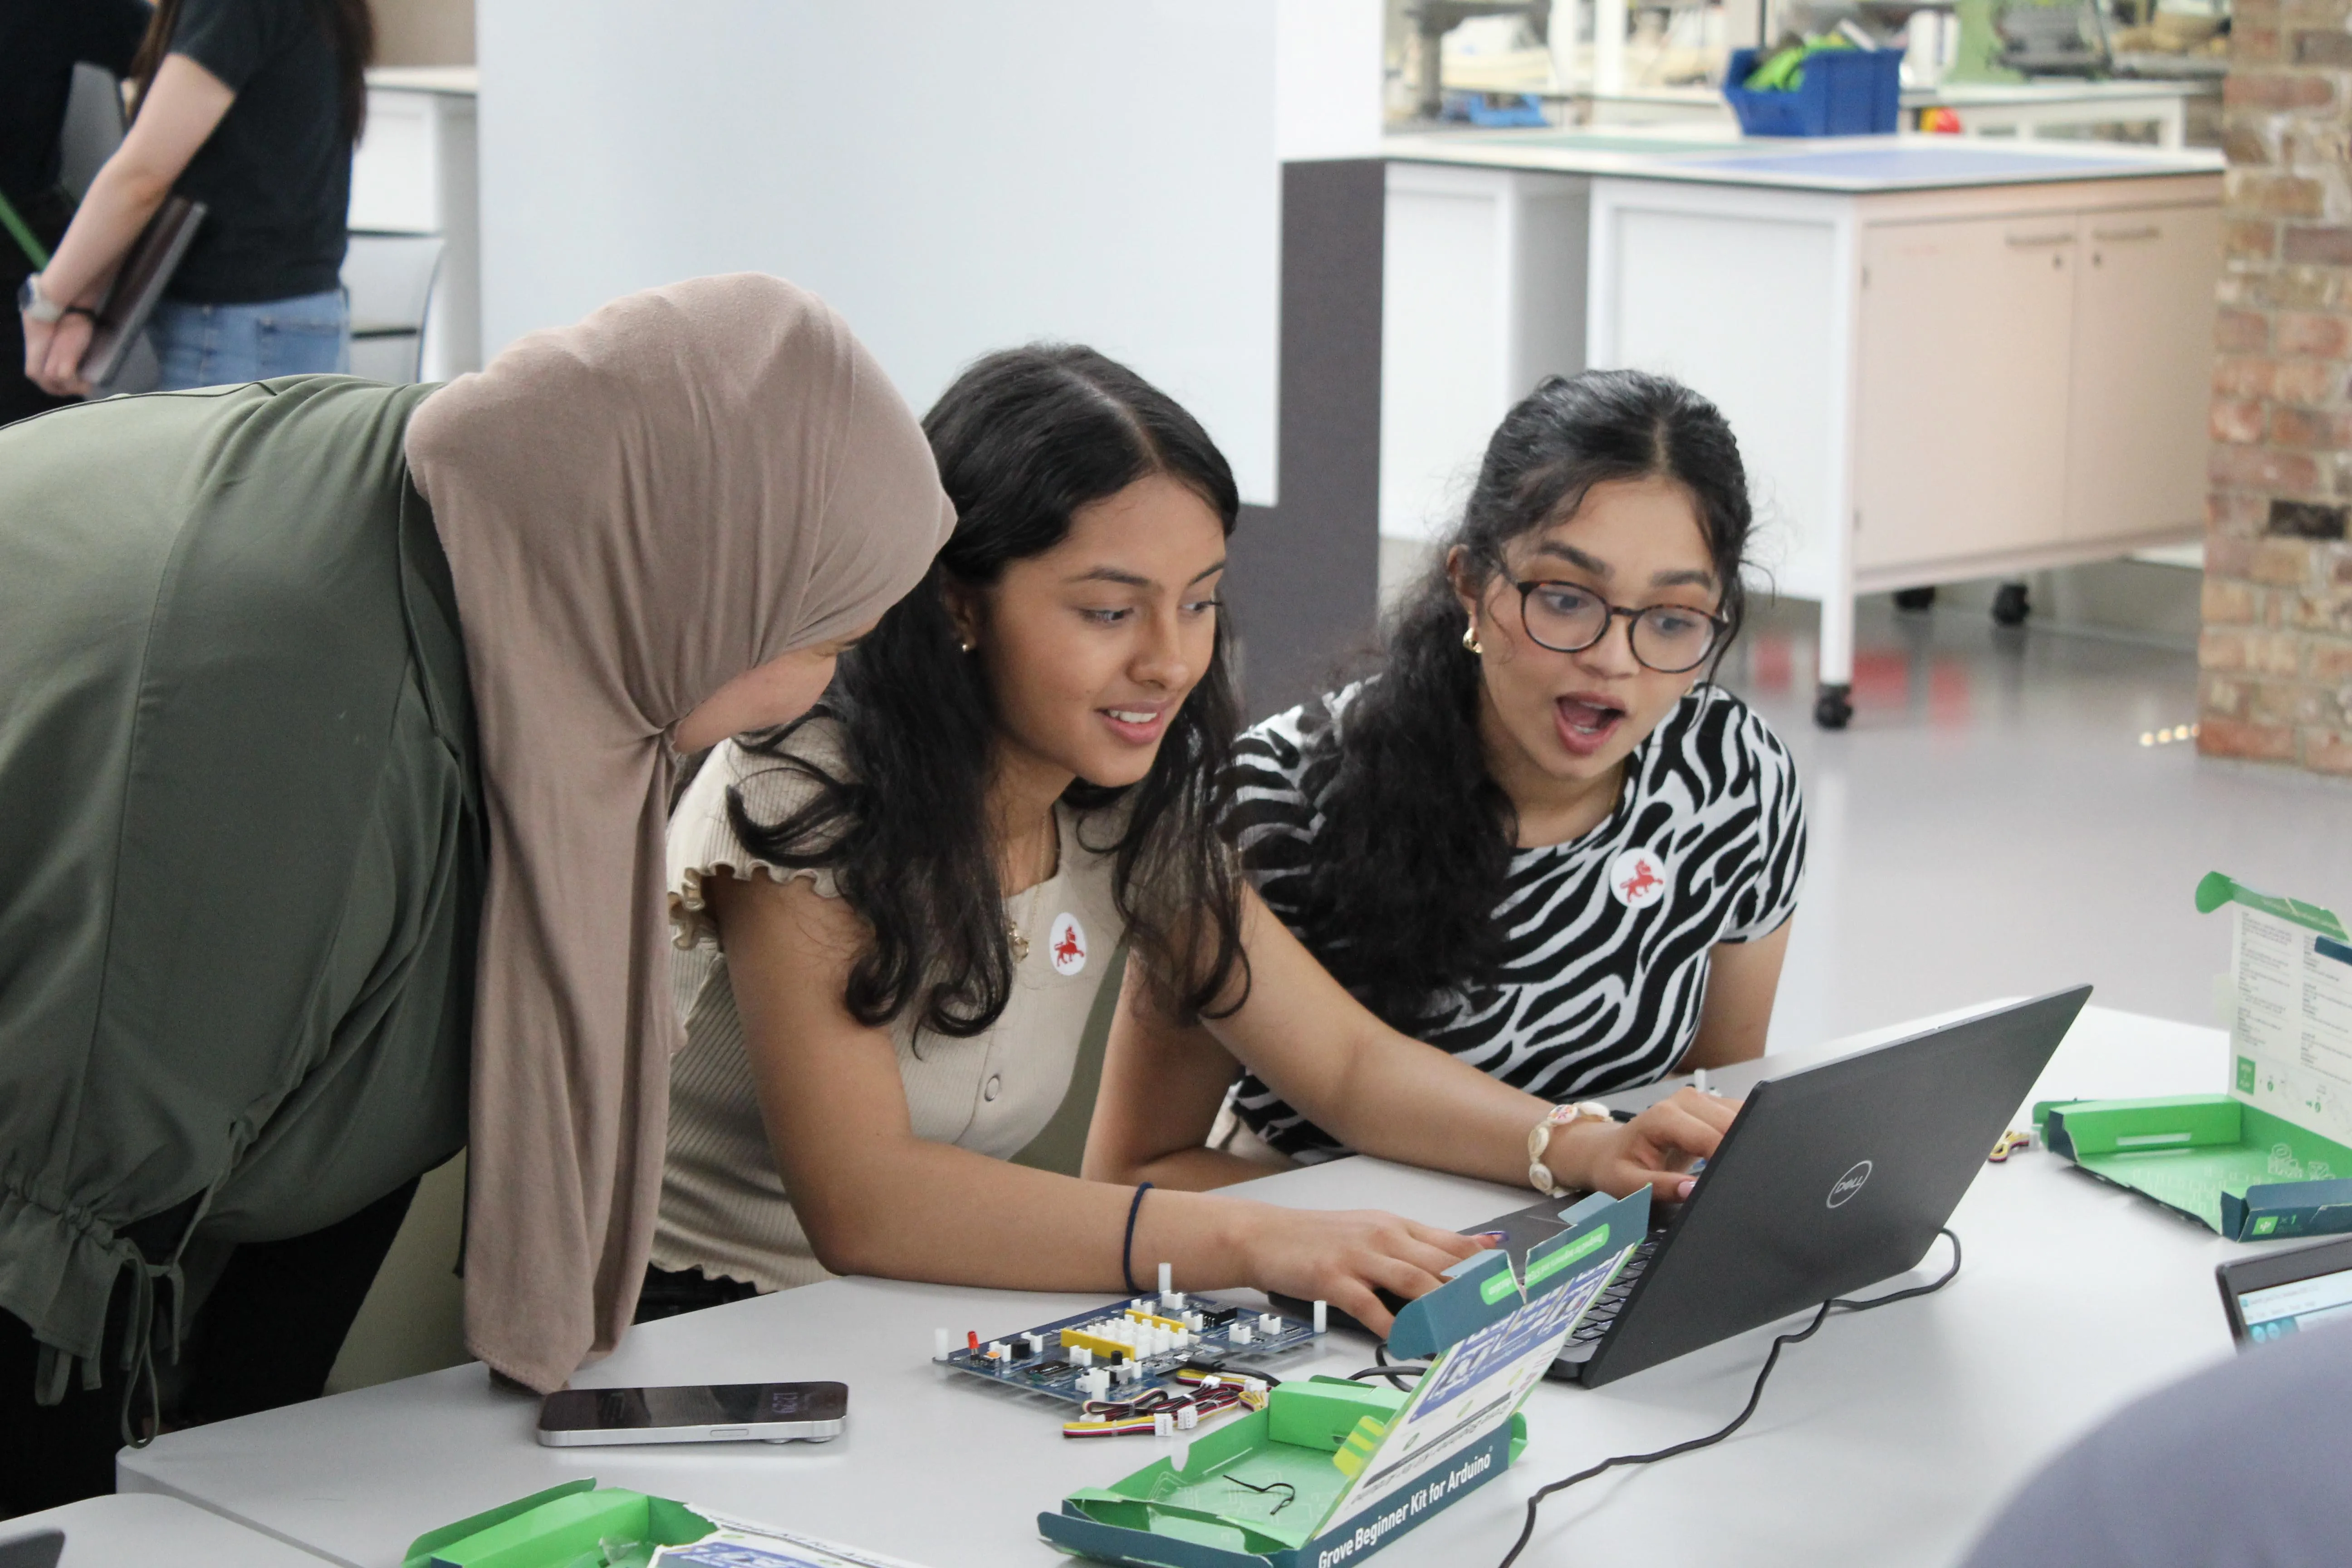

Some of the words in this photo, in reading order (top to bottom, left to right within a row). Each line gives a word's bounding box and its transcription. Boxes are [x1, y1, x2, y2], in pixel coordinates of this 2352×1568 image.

[1834, 1176, 1863, 1194] DELL
[1318, 1539, 1354, 1568] Grove
[1354, 1503, 1409, 1551] Beginner
[1410, 1489, 1428, 1515] Kit
[1429, 1480, 1446, 1504] for
